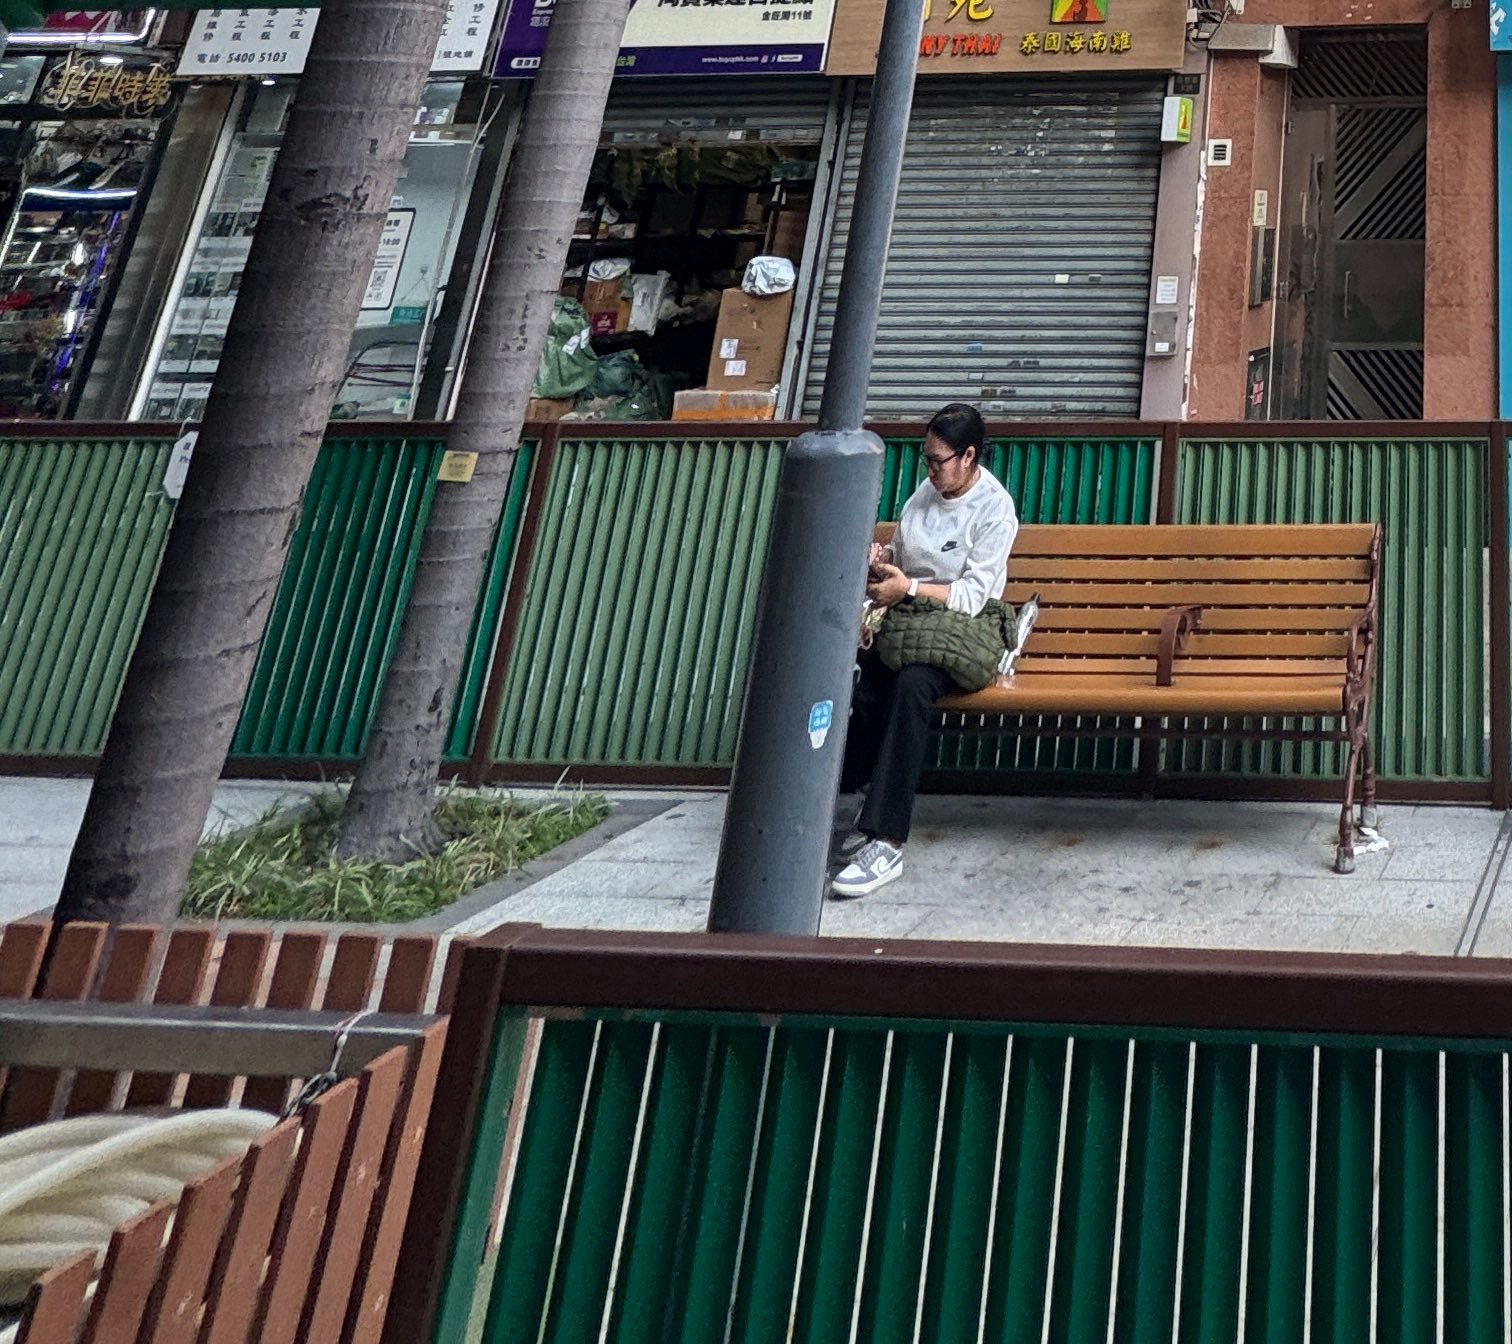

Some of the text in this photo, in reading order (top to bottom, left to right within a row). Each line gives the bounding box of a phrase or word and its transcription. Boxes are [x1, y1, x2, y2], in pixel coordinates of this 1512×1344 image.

[1020, 31, 1132, 54] 泰國海南雞
[226, 52, 256, 64] 5400
[258, 52, 288, 63] 5103
